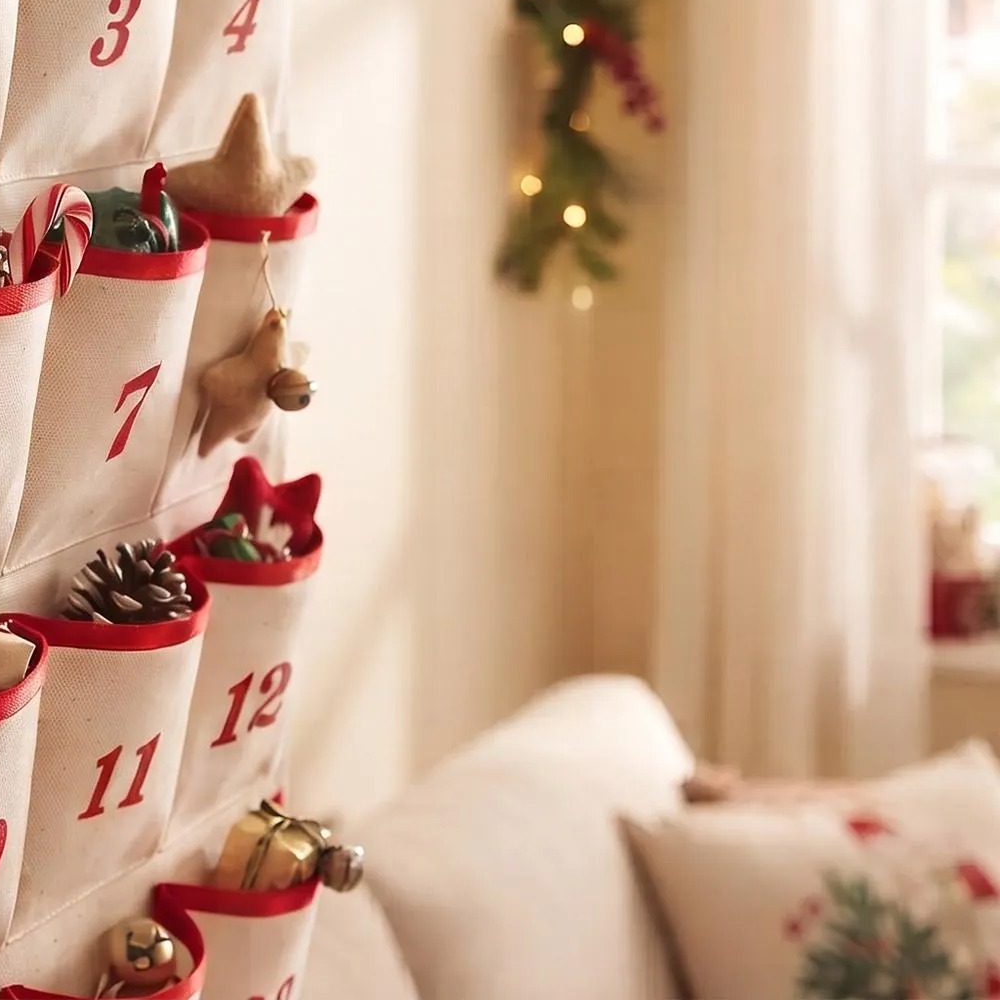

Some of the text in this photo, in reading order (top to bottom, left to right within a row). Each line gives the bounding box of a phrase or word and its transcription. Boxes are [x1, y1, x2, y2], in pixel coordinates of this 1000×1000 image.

[106, 363, 160, 461] 7
[210, 661, 292, 749] 12
[77, 733, 161, 821] 11
